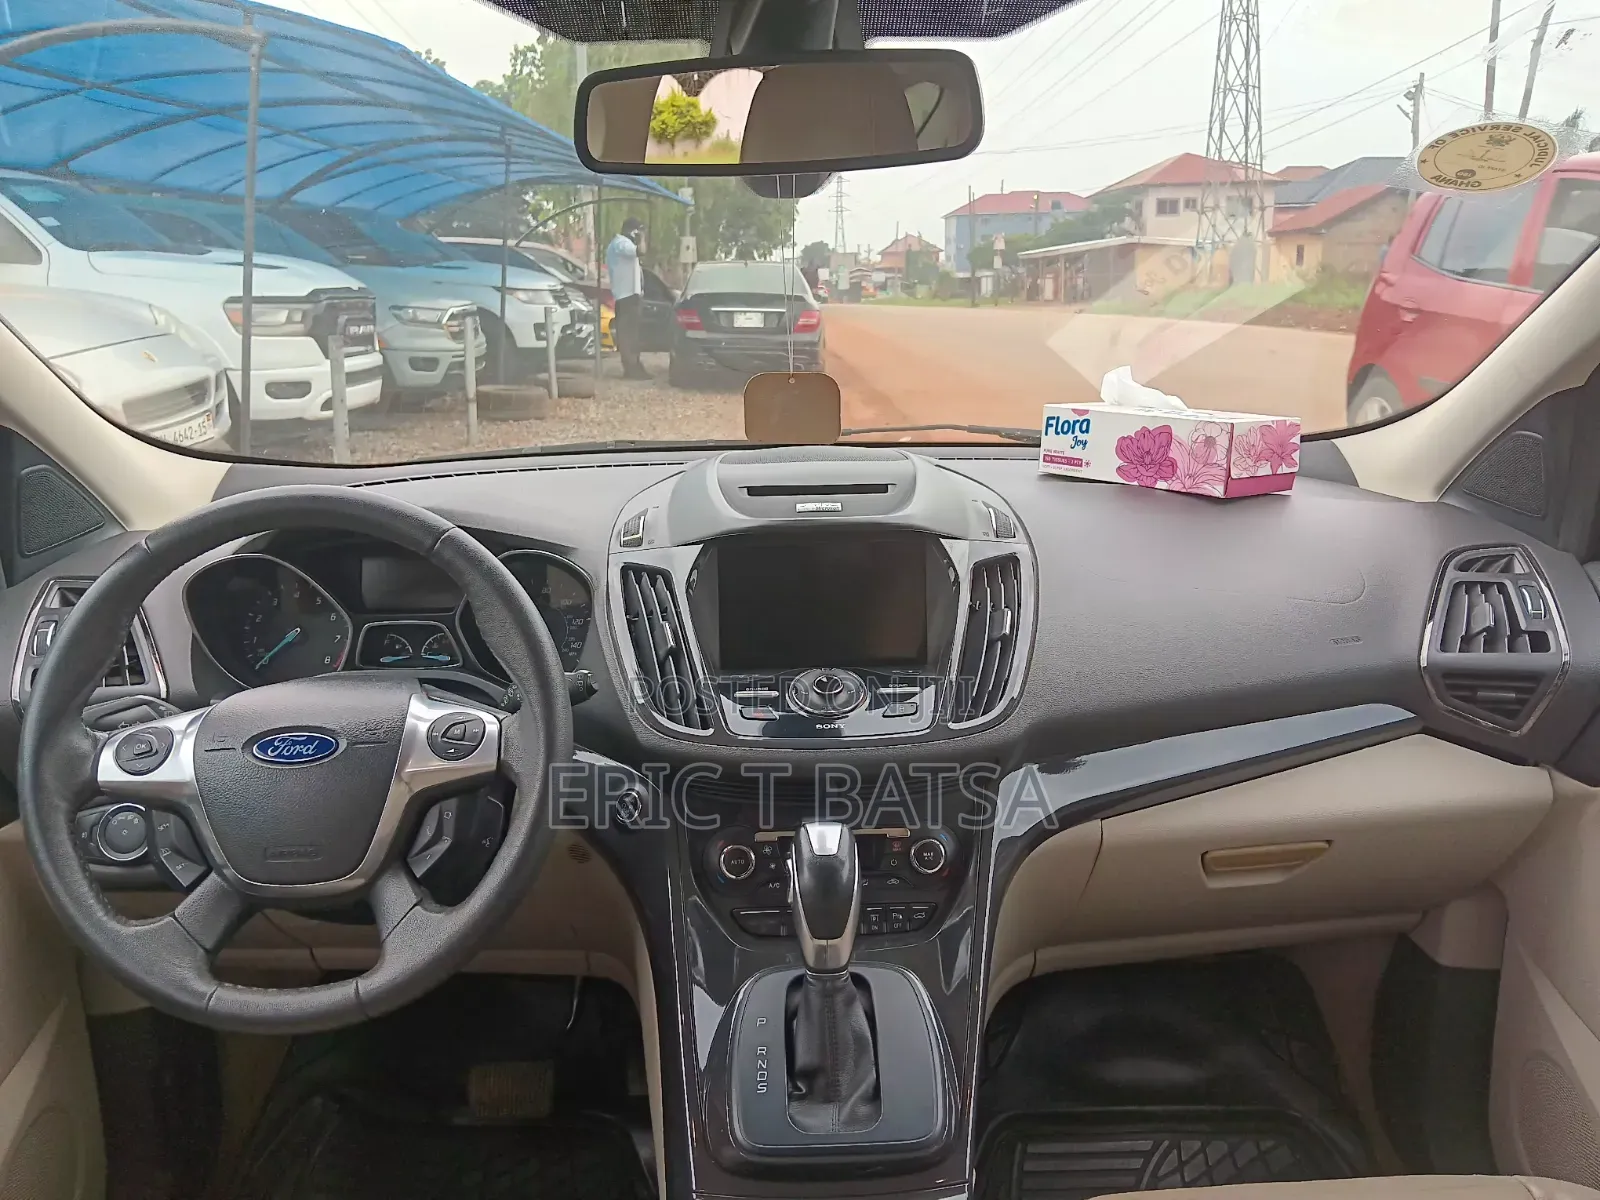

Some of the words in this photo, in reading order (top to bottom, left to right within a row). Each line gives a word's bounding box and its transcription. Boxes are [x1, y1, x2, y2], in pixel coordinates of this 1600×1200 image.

[1045, 416, 1091, 436] Flora
[1070, 435, 1089, 450] Joy
[330, 613, 336, 621] 6
[334, 635, 341, 643] 7
[324, 656, 331, 664] 8
[268, 736, 320, 757] Ford
[756, 1017, 767, 1028] P
[756, 1046, 767, 1056] R
[757, 1059, 768, 1069] N
[756, 1071, 768, 1081] D
[756, 1082, 768, 1094] S
